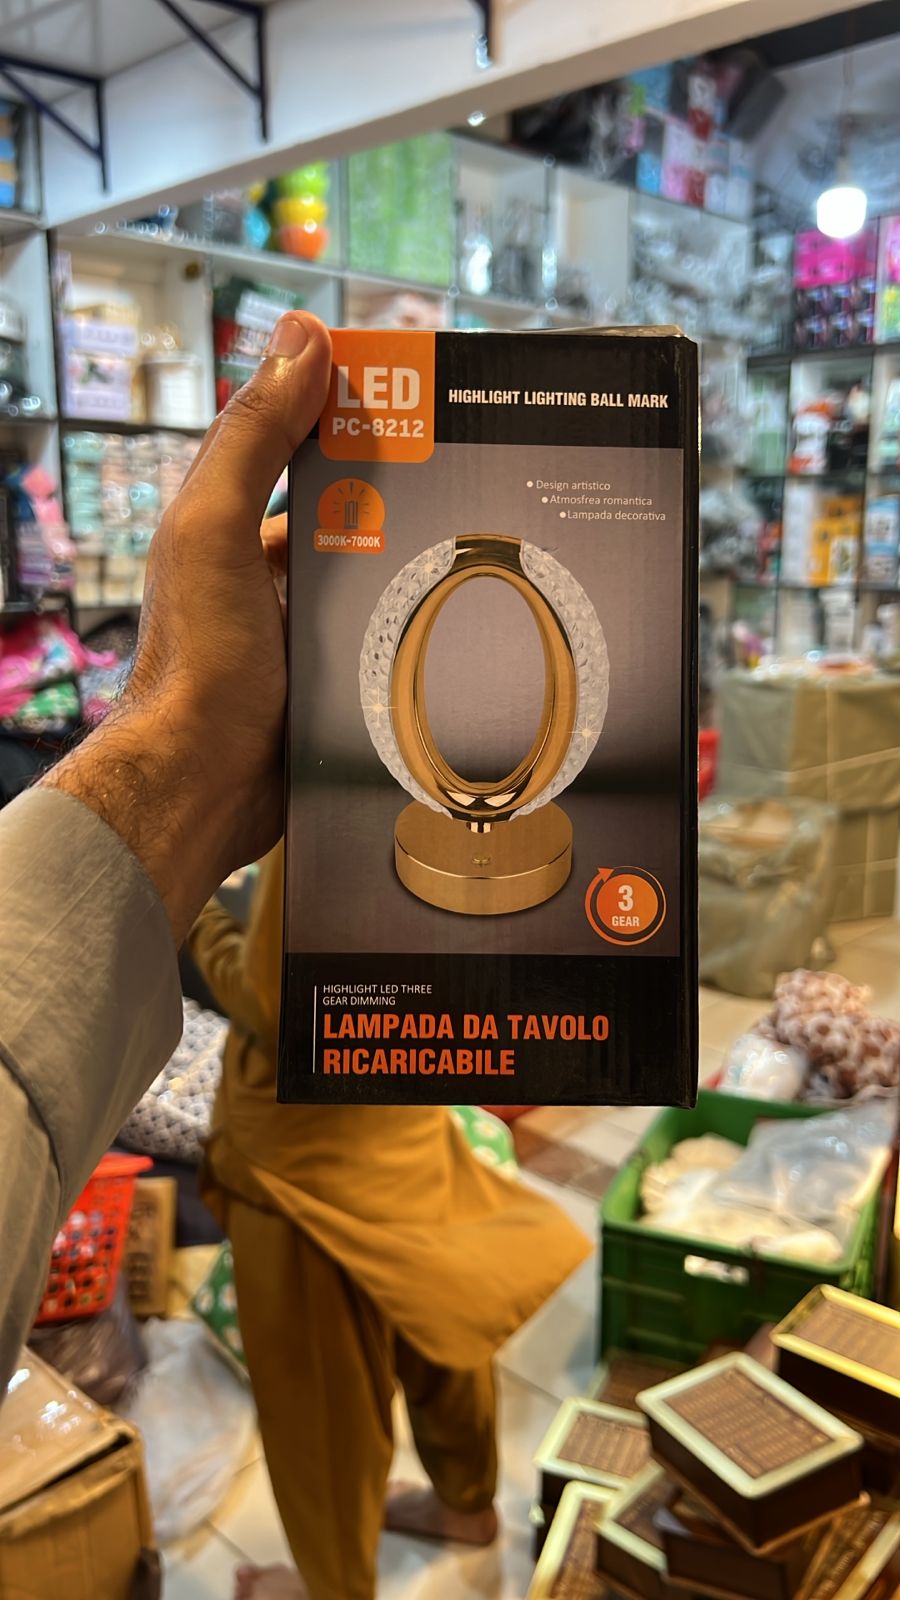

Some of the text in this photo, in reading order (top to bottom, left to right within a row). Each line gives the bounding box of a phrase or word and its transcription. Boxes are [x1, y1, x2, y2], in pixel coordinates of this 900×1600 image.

[337, 366, 421, 410] LED
[448, 389, 669, 409] HIGHLIGHT LIGHTING BALL MARK
[332, 417, 424, 438] PC-8212
[536, 479, 611, 492] Design artistico
[550, 494, 652, 506] Atmosfrea romantica
[567, 509, 666, 522] Lampada decorativa
[317, 534, 381, 548] 3000K-7000K
[617, 884, 634, 912] 3
[611, 915, 640, 927] GEAR
[323, 984, 432, 994] HIGHLIGHT LED THREE
[322, 996, 396, 1006] GEAR DIMMING
[323, 1013, 610, 1041] LAMPADA DA TAVOLO
[323, 1048, 515, 1076] RICARICABILE
